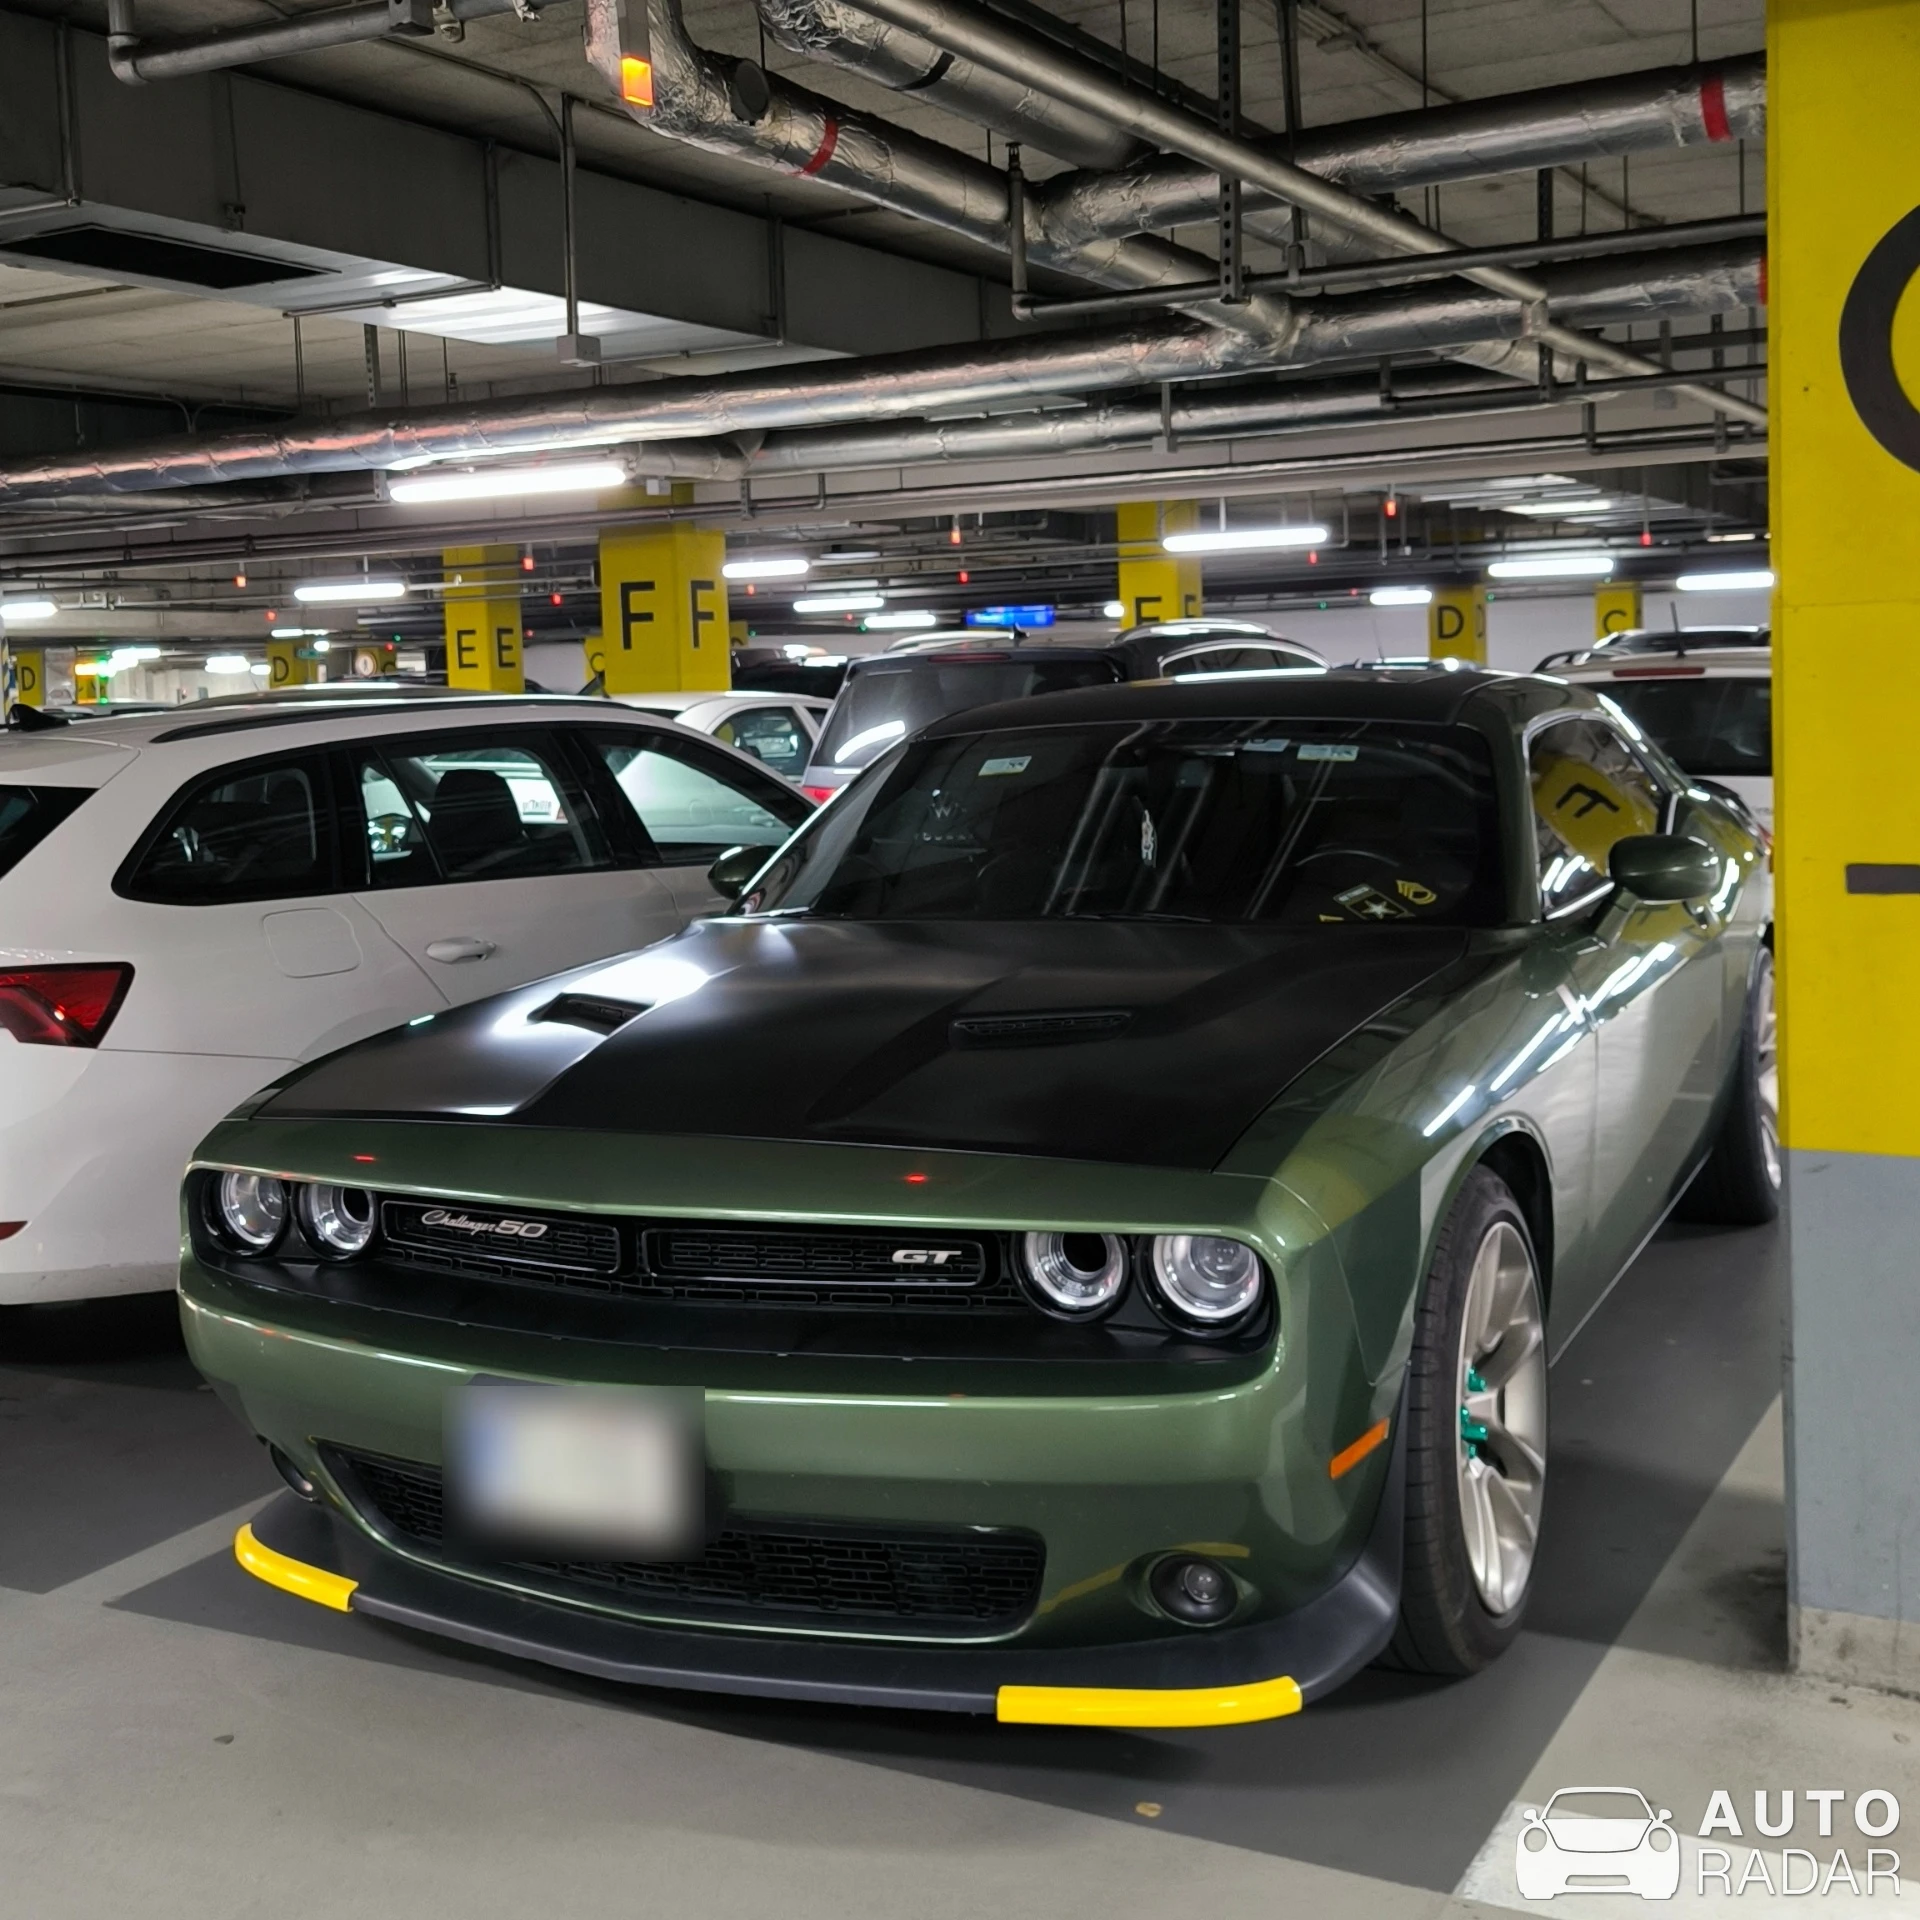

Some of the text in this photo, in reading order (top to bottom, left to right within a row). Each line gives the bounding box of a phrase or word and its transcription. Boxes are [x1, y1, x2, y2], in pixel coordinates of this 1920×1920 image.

[620, 581, 656, 650] F
[690, 580, 715, 649] F
[1437, 605, 1465, 639] D
[456, 629, 478, 669] E
[496, 628, 517, 668] E
[21, 665, 36, 692] D
[273, 655, 290, 682] D
[495, 1219, 548, 1238] 50
[892, 1249, 962, 1264] GT
